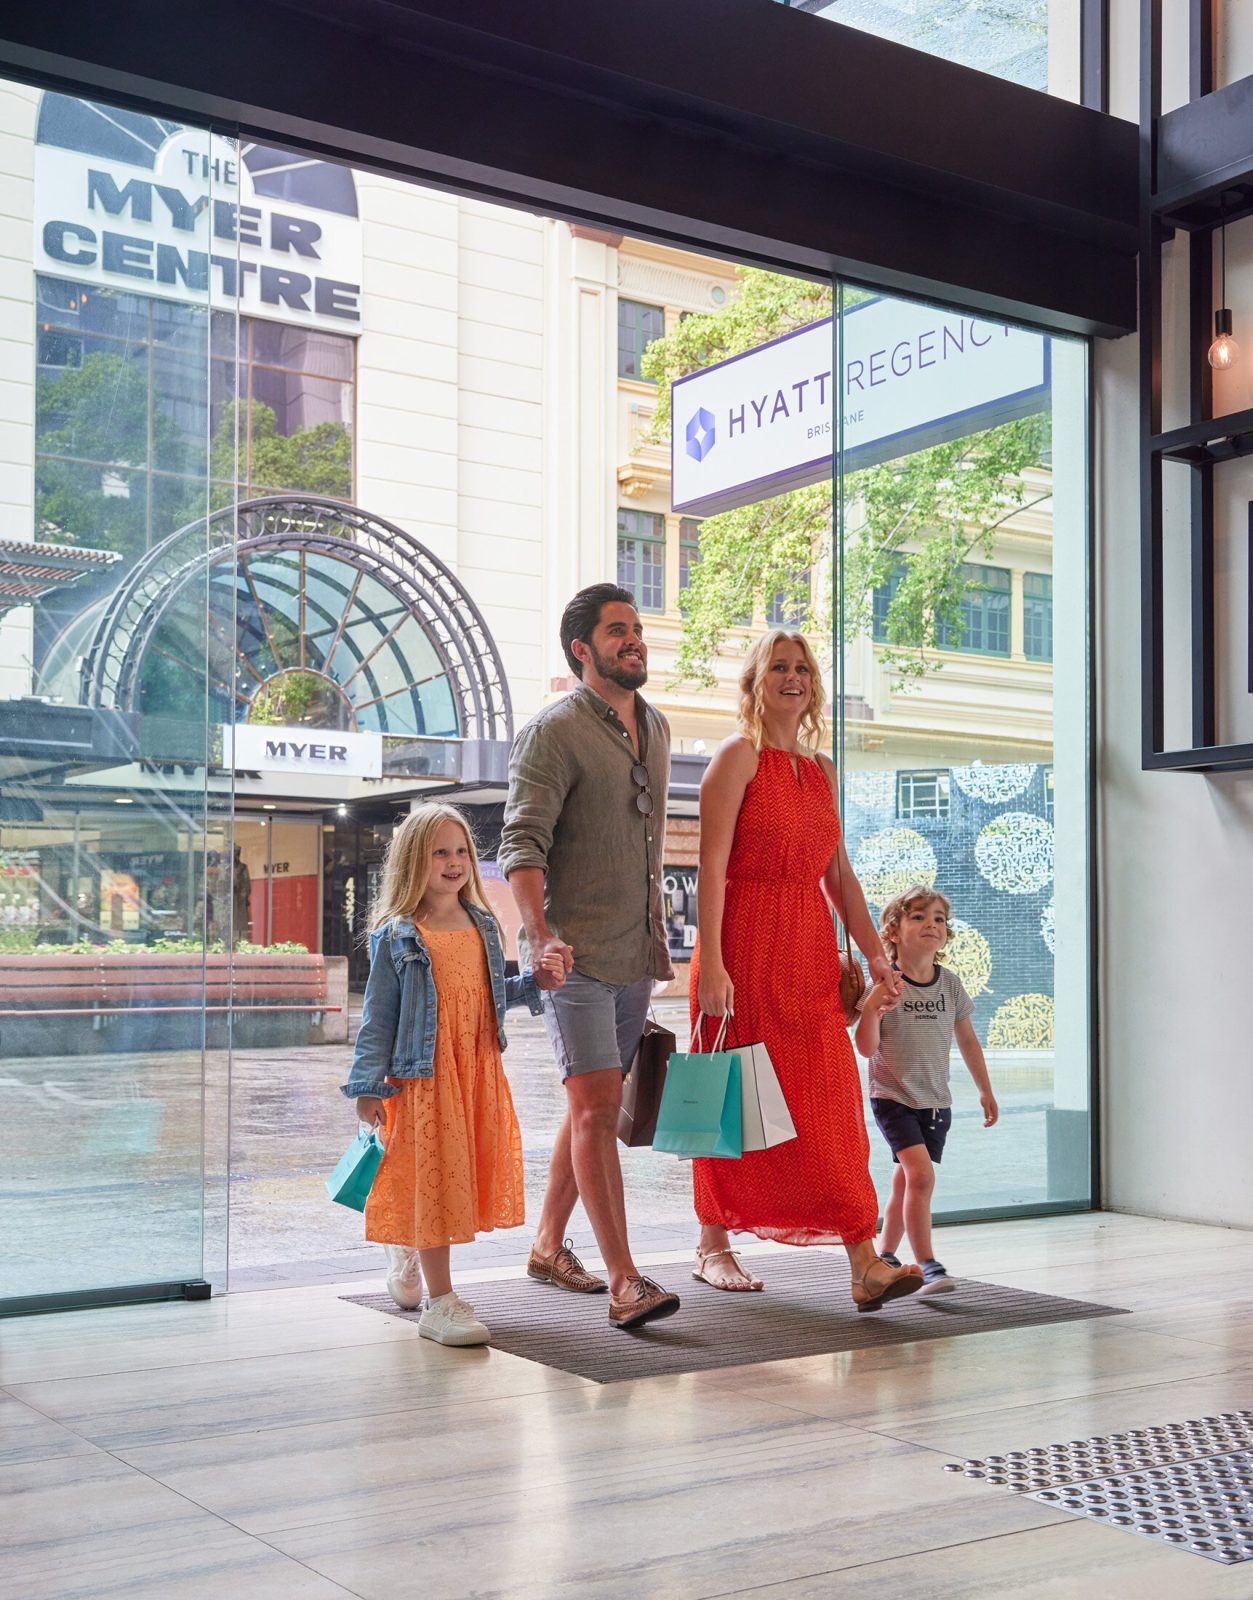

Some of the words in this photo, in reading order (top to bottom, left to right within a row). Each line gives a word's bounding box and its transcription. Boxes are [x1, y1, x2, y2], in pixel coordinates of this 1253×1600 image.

[182, 149, 238, 186] THE
[88, 169, 322, 260] MYER
[43, 220, 361, 321] CENTRE
[729, 371, 831, 438] HYATT
[807, 409, 865, 439] BRISANE
[265, 741, 348, 761] MYER
[903, 994, 946, 1012] seed
